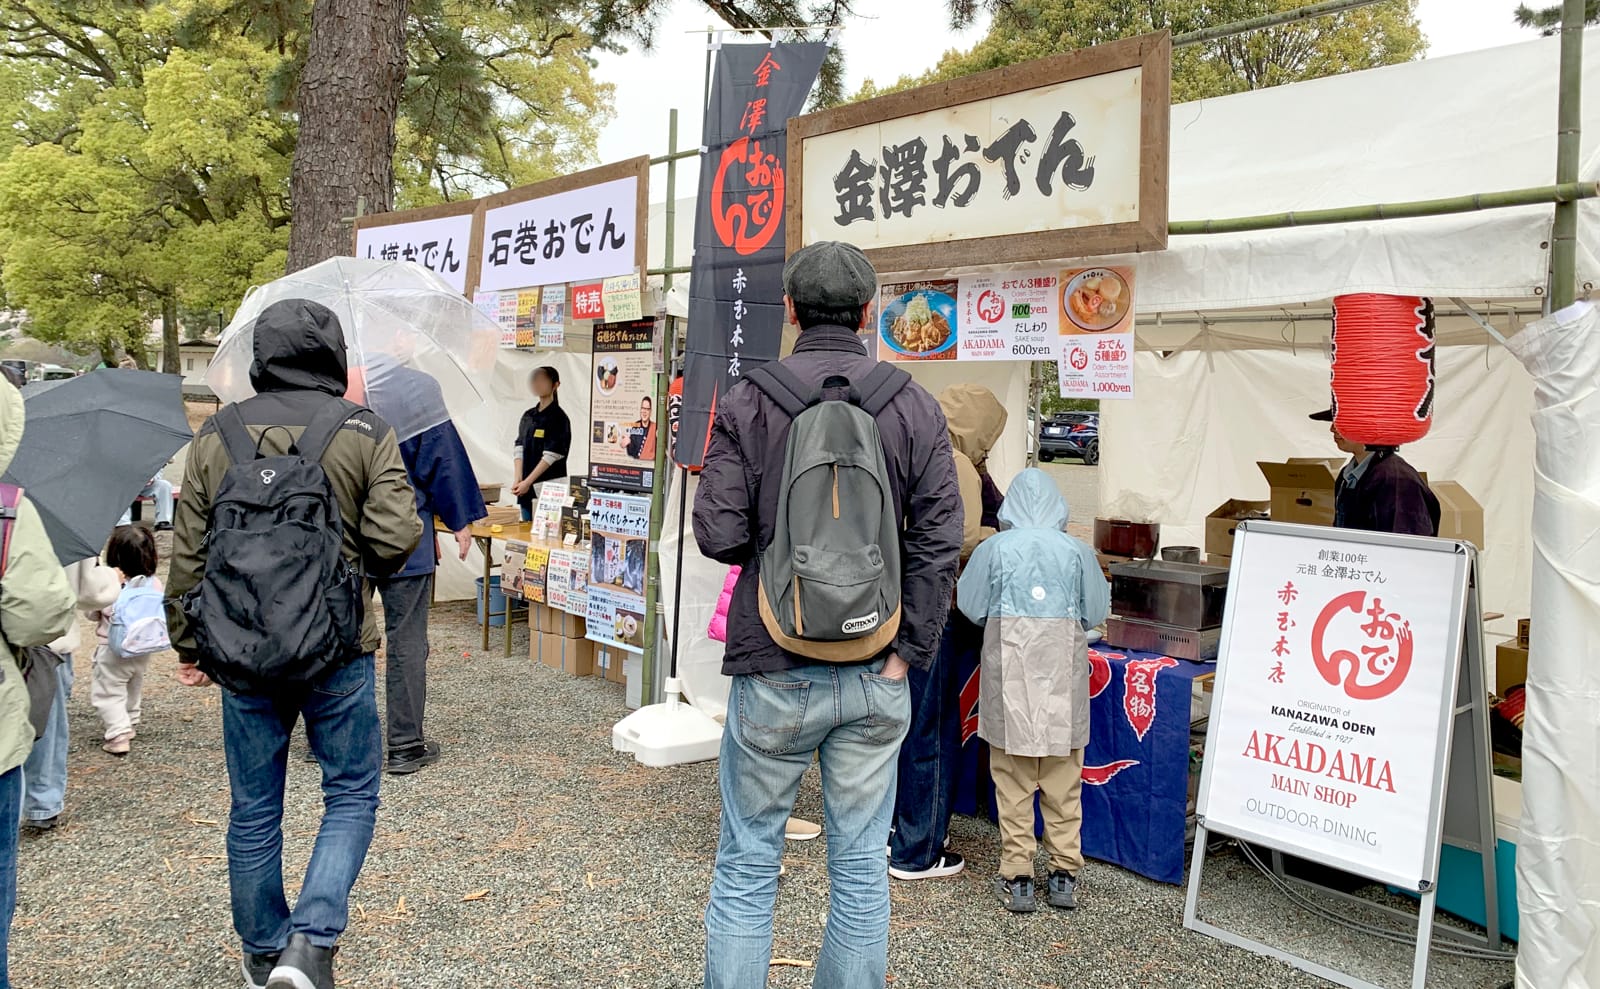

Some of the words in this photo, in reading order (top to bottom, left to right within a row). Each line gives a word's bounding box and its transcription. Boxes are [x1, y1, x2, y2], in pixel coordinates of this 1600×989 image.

[740, 52, 781, 134] 金澤
[832, 110, 1096, 227] 金澤おでん
[488, 207, 626, 267] 石巻おでん
[1001, 277, 1057, 290] おでん3種盛り
[575, 290, 601, 314] 特売
[1015, 322, 1048, 333] だしわり
[962, 338, 1006, 350] AKADAMA
[1012, 344, 1051, 355] 600yen
[1097, 339, 1125, 350] おでん
[1094, 350, 1127, 362] 5種盛り
[1092, 382, 1131, 393] 1,000yen
[591, 510, 648, 529] サバだしラーメン
[1318, 548, 1368, 565] 創業100年
[1296, 563, 1318, 576] 元祖
[1321, 564, 1387, 584] 金澤おでん
[1130, 671, 1151, 718] 名物
[1297, 699, 1342, 716] ORIGINATOR
[1343, 709, 1351, 717] of
[1271, 705, 1339, 728] KANAZAWA
[1342, 721, 1376, 737] ODEN
[1288, 722, 1325, 739] Established
[1325, 732, 1332, 740] in
[1242, 730, 1397, 793] AKADAMA
[1270, 774, 1310, 797] MAIN
[1314, 784, 1357, 808] SHOP
[1246, 798, 1318, 830] OUTDOOR
[1323, 819, 1377, 847] DINING
